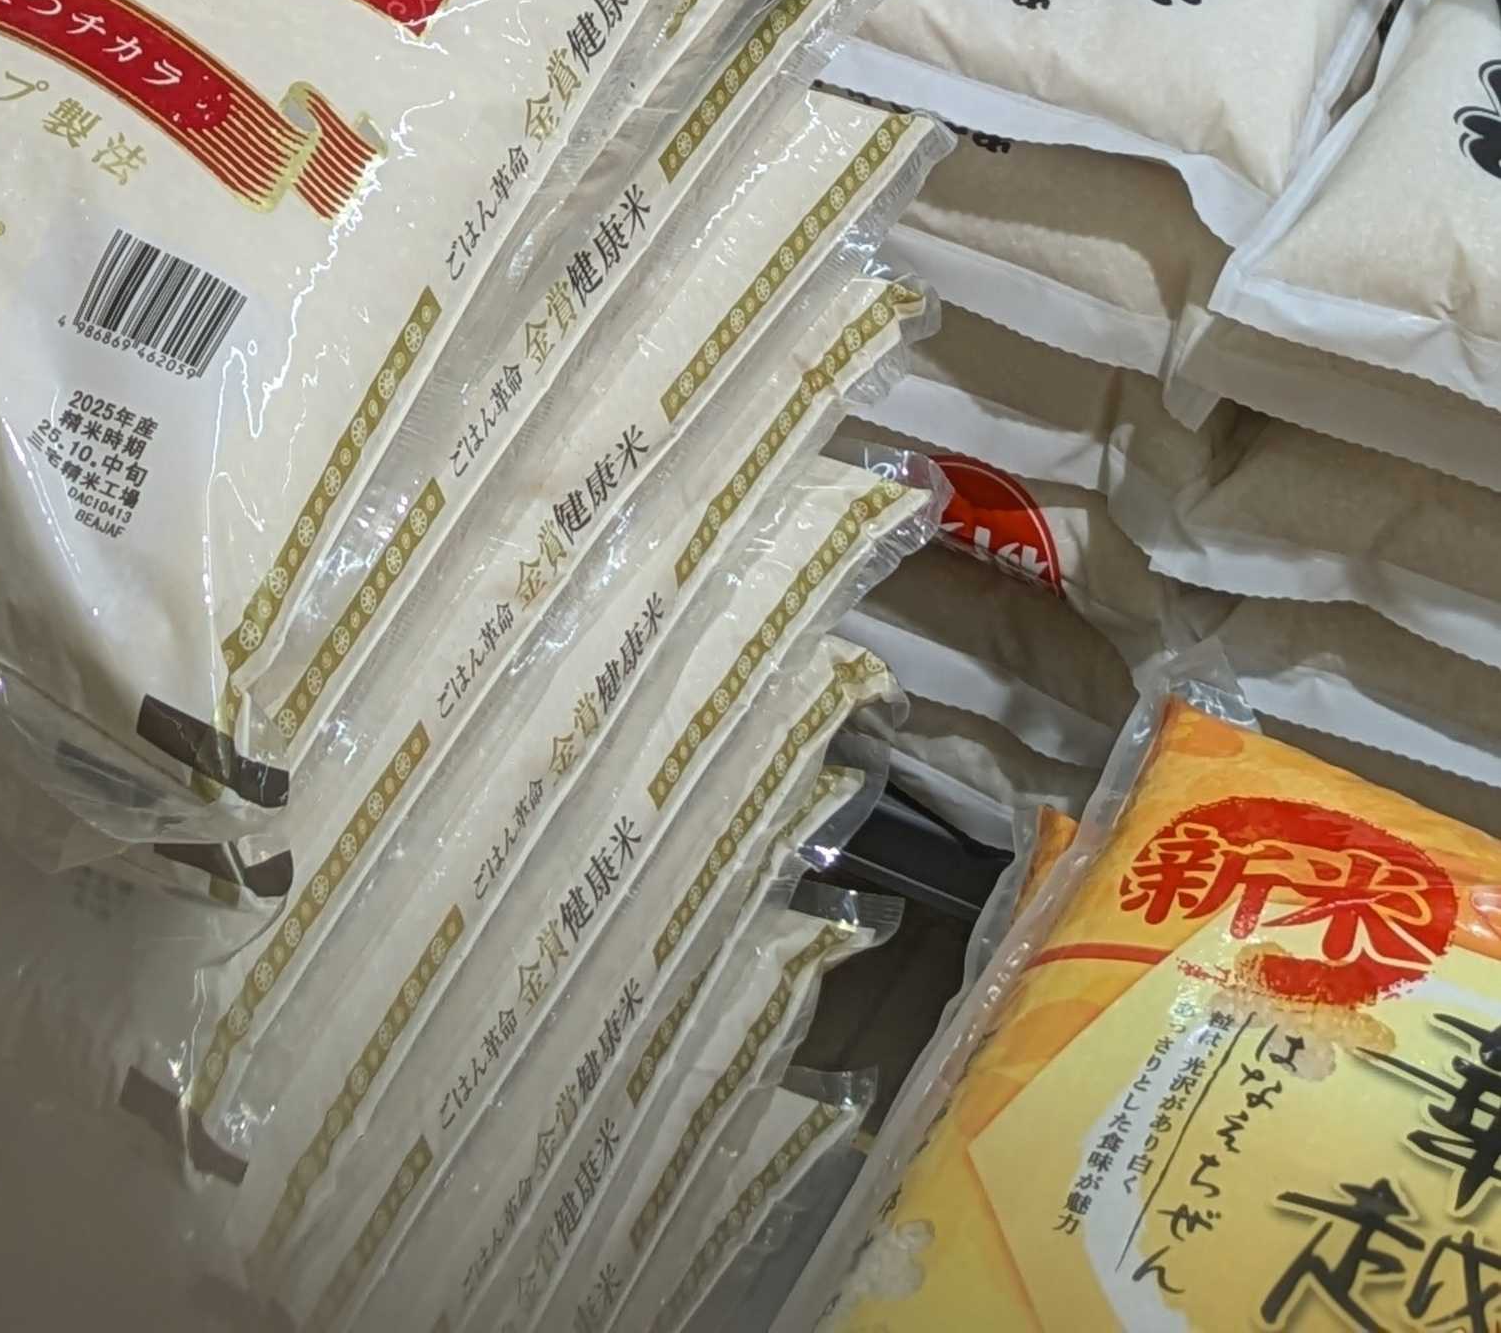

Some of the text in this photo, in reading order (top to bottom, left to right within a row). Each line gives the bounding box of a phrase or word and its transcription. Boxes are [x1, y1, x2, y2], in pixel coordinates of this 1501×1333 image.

[446, 144, 530, 282] ごはん革命
[521, 183, 652, 372] 金賞健康米
[57, 315, 197, 380] 4 986869 462059
[26, 429, 142, 510] 三宅精米工場
[37, 418, 149, 488] 25.10.中旬
[58, 408, 148, 461] 精米時期
[68, 390, 159, 441] 2025年産
[449, 362, 525, 479] ごはん革命
[67, 486, 133, 524] DAC10413
[515, 425, 650, 611] 金賞健康米
[435, 602, 516, 721] ごはん革命
[547, 590, 666, 777] 金賞健康米
[473, 778, 546, 901] ごはん革命
[1120, 823, 1435, 967] 新米
[517, 814, 643, 1013] 金賞健康米
[438, 1008, 519, 1130] ごはん革命
[535, 978, 644, 1179] 金賞健康米
[1054, 1002, 1197, 1235] あっさりとした食味が魅力
[1122, 1008, 1238, 1195] 粒は、光沢があり白く
[1132, 1022, 1307, 1295] はなえちぜん
